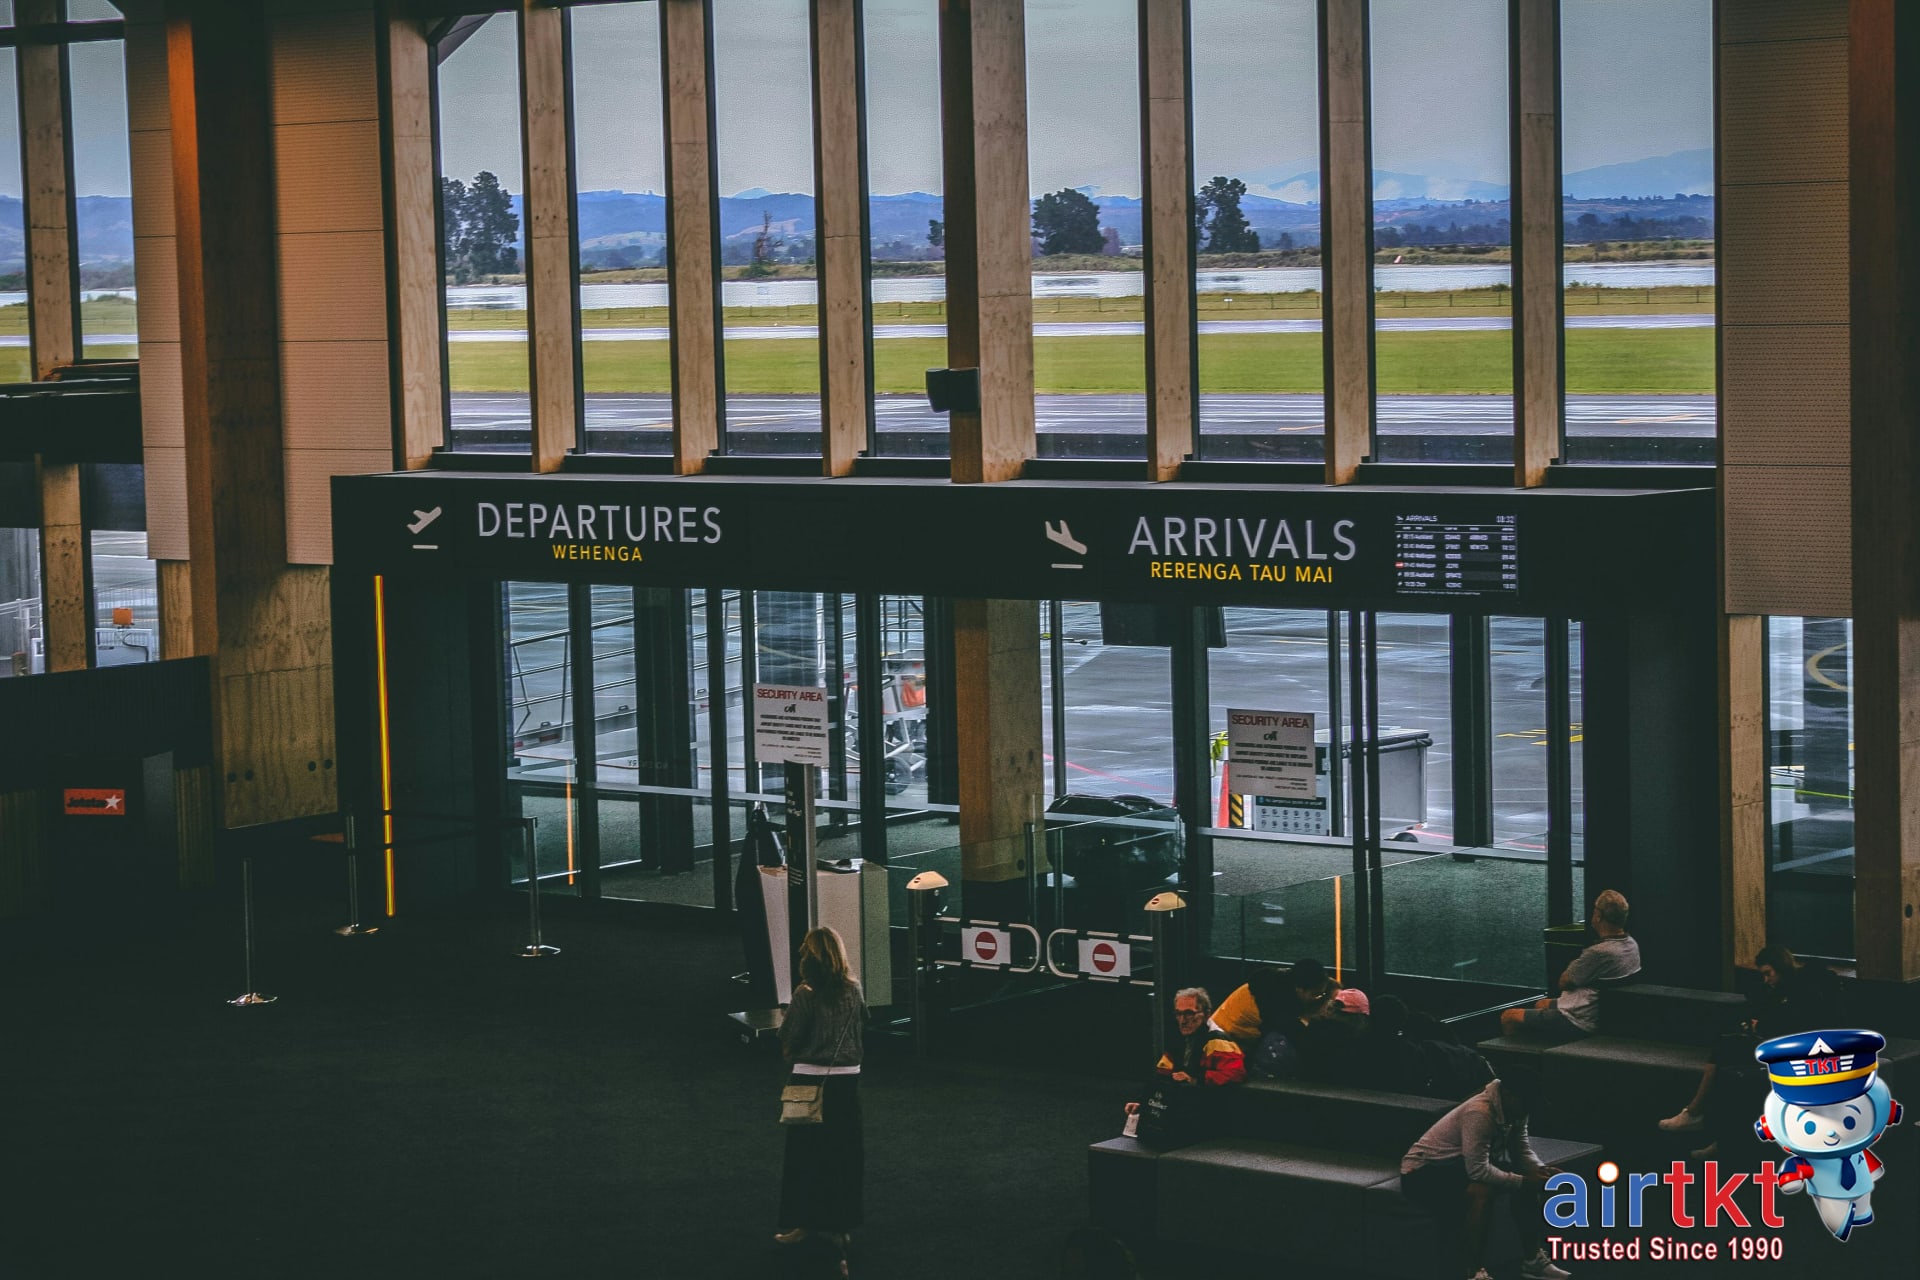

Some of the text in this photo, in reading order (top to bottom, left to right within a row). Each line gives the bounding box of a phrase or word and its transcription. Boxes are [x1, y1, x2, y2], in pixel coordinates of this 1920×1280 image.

[477, 502, 722, 544] DEPARTURES
[1127, 515, 1357, 561] ARRIVALS
[551, 544, 644, 563] WEHENGA
[1151, 561, 1333, 583] RERENGA TAU MAI
[757, 688, 823, 703] SECURITY AREA
[1231, 714, 1309, 728] SECURITY AREA
